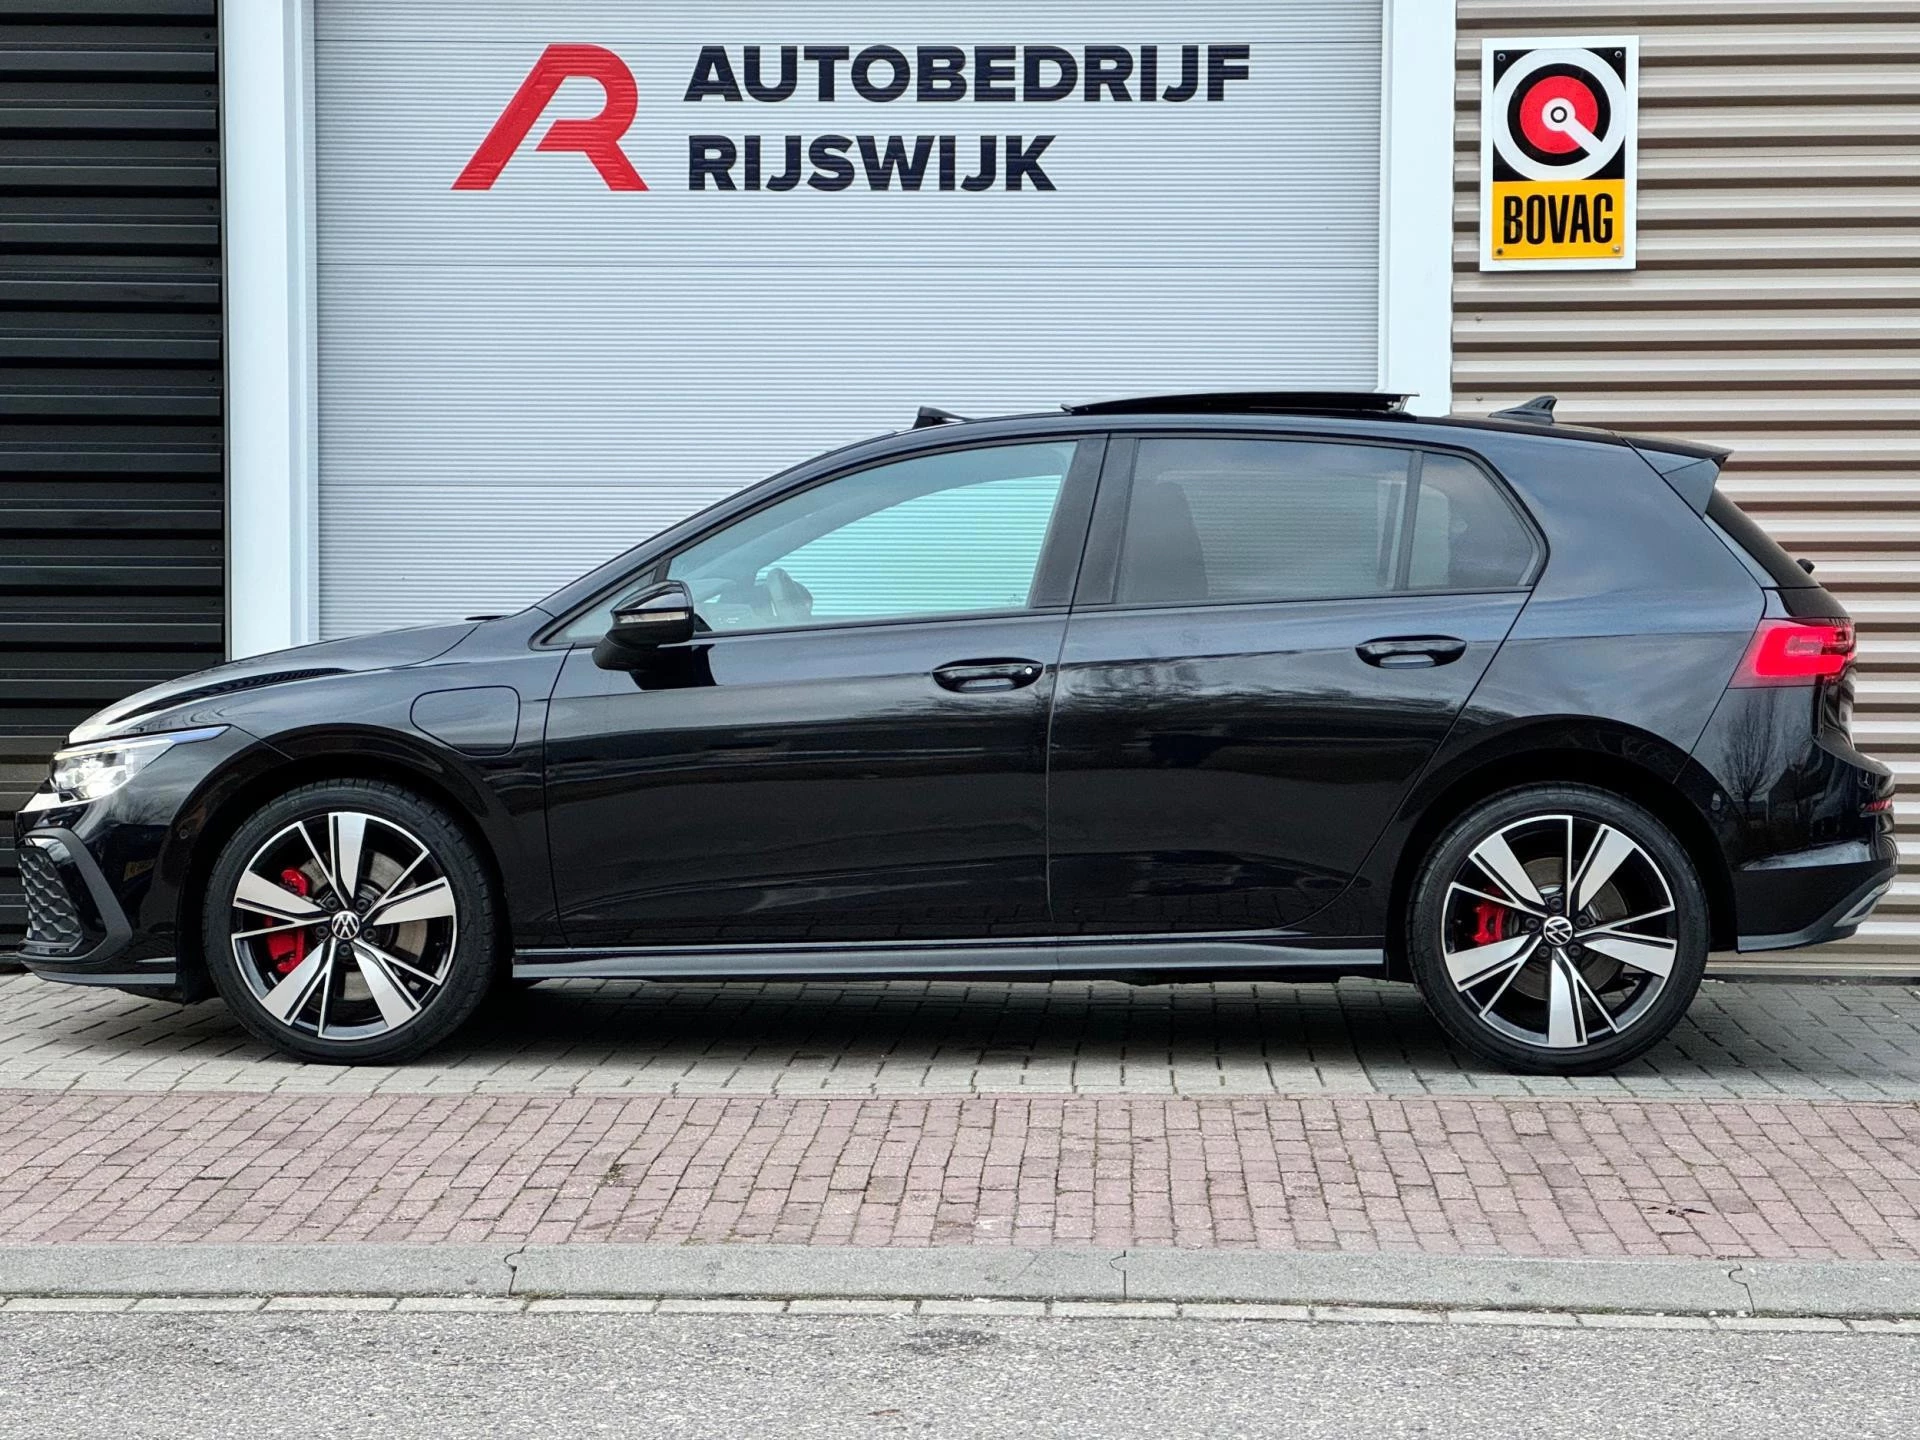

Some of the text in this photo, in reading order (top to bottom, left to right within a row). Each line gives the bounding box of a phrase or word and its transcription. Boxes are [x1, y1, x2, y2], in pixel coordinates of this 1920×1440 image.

[684, 45, 1250, 102] AUTOBEDRIJF
[689, 135, 1056, 191] RIJSWIJK
[1503, 193, 1613, 244] BOVAG
